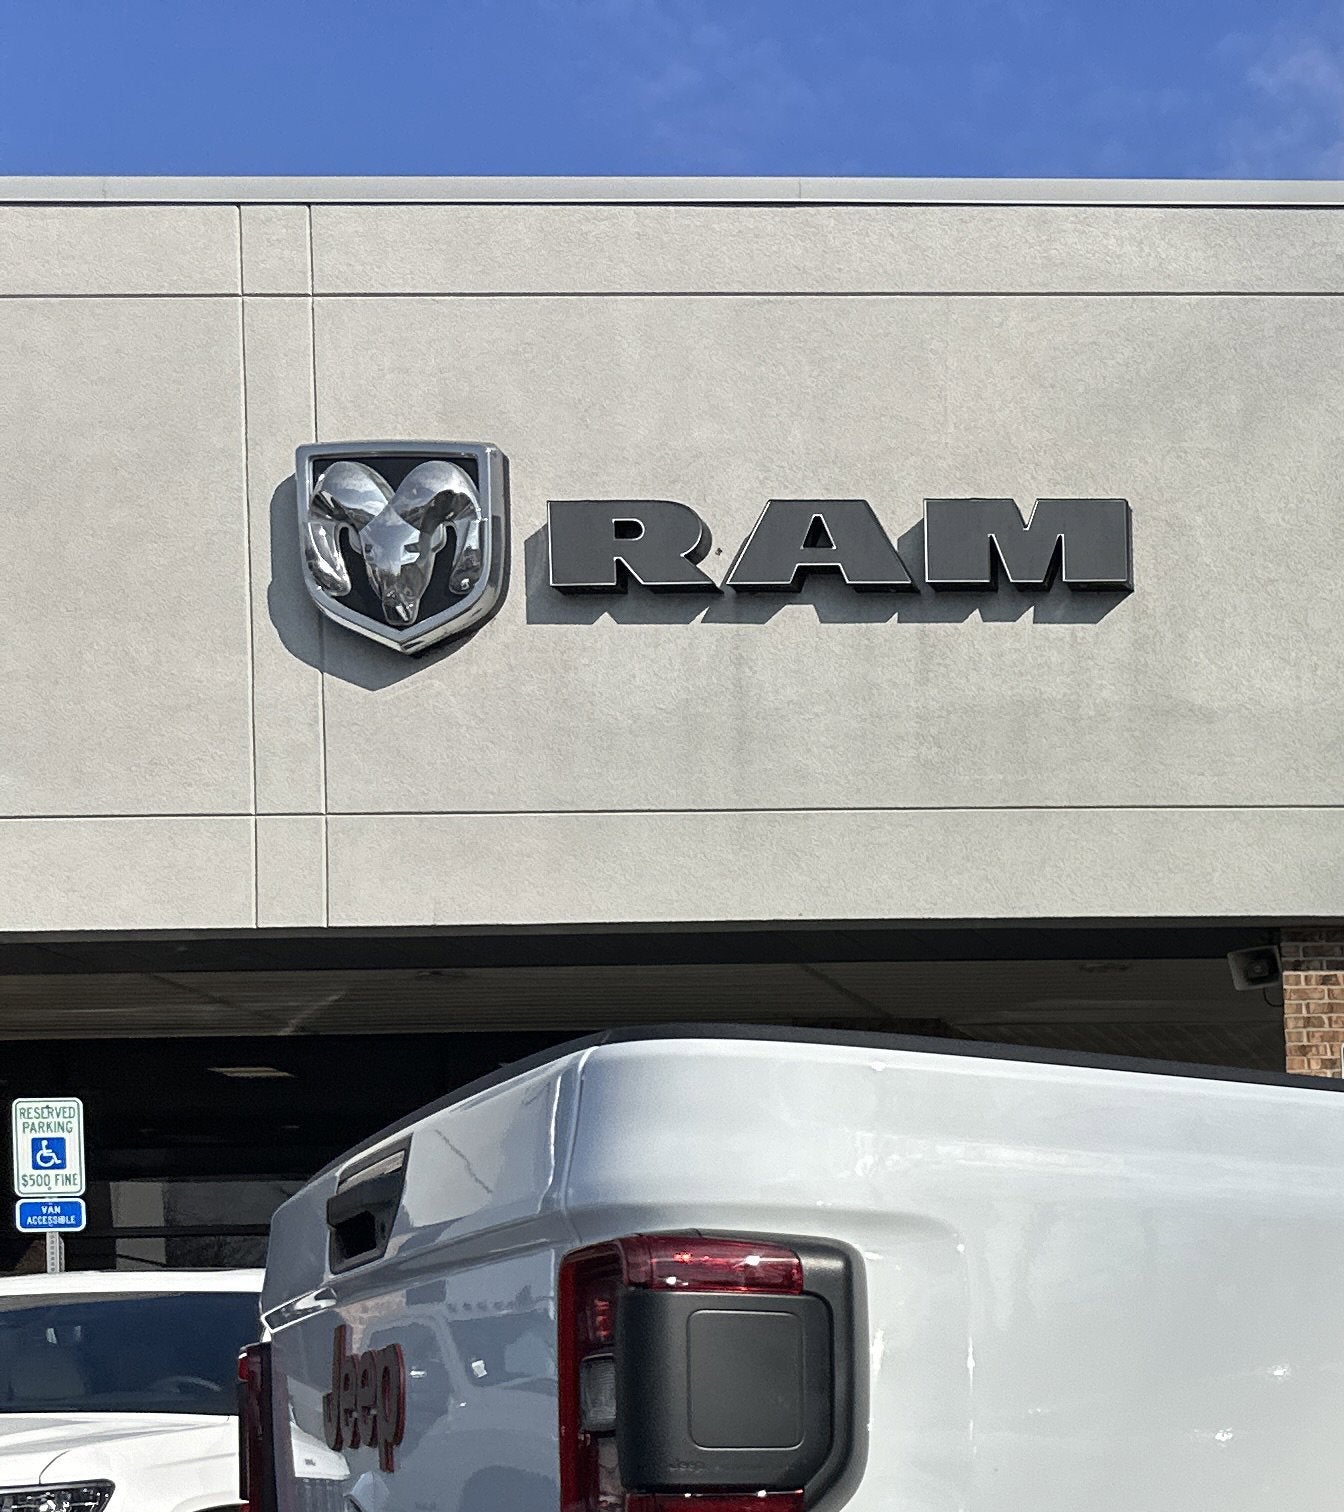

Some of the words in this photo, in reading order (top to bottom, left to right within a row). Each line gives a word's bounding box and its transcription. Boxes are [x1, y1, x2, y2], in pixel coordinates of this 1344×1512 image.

[546, 498, 1132, 590] RAM
[19, 1106, 76, 1120] RESERVED
[22, 1121, 73, 1134] PARKING
[21, 1174, 50, 1187] $500
[54, 1173, 78, 1187] FINE
[41, 1205, 61, 1214] VAN
[26, 1215, 76, 1225] ACCESSIBLE
[322, 1324, 406, 1473] Jeep
